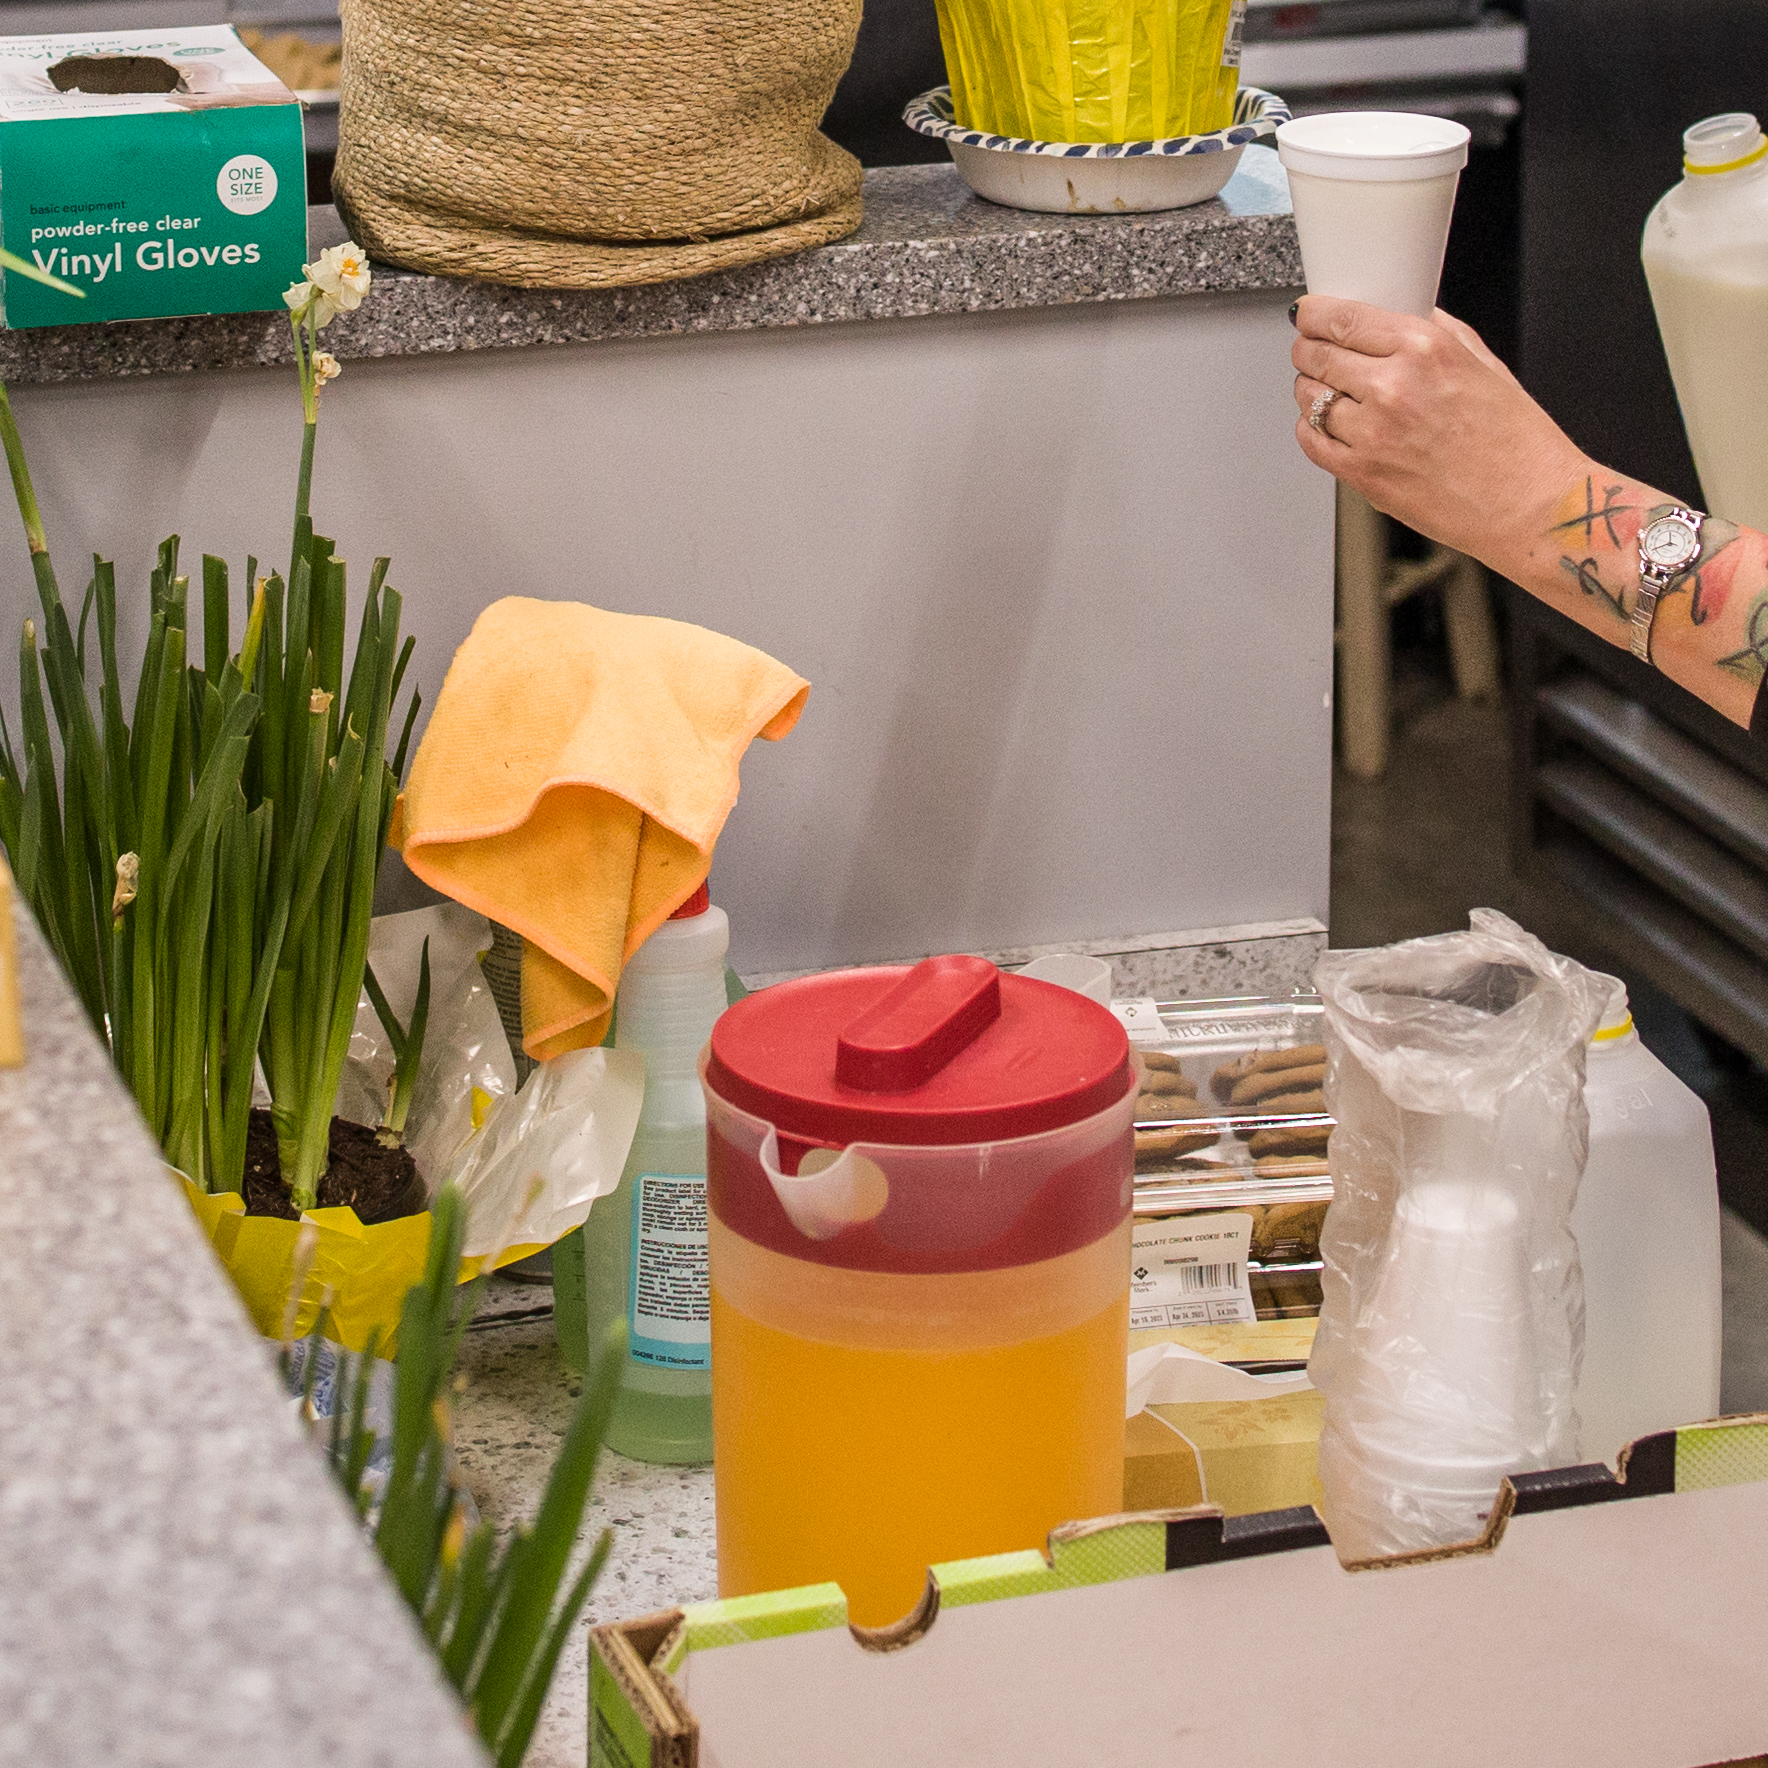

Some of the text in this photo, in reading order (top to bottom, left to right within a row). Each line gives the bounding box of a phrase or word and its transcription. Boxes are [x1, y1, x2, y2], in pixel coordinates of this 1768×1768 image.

[229, 167, 263, 180] ONE
[231, 183, 263, 195] SIZE
[30, 200, 126, 214] basic equipment
[31, 215, 201, 243] powder-free clear
[32, 238, 260, 283] Vinyl Gloves
[1169, 1236, 1193, 1244] CHUNK
[1195, 1234, 1220, 1242] COOKIE
